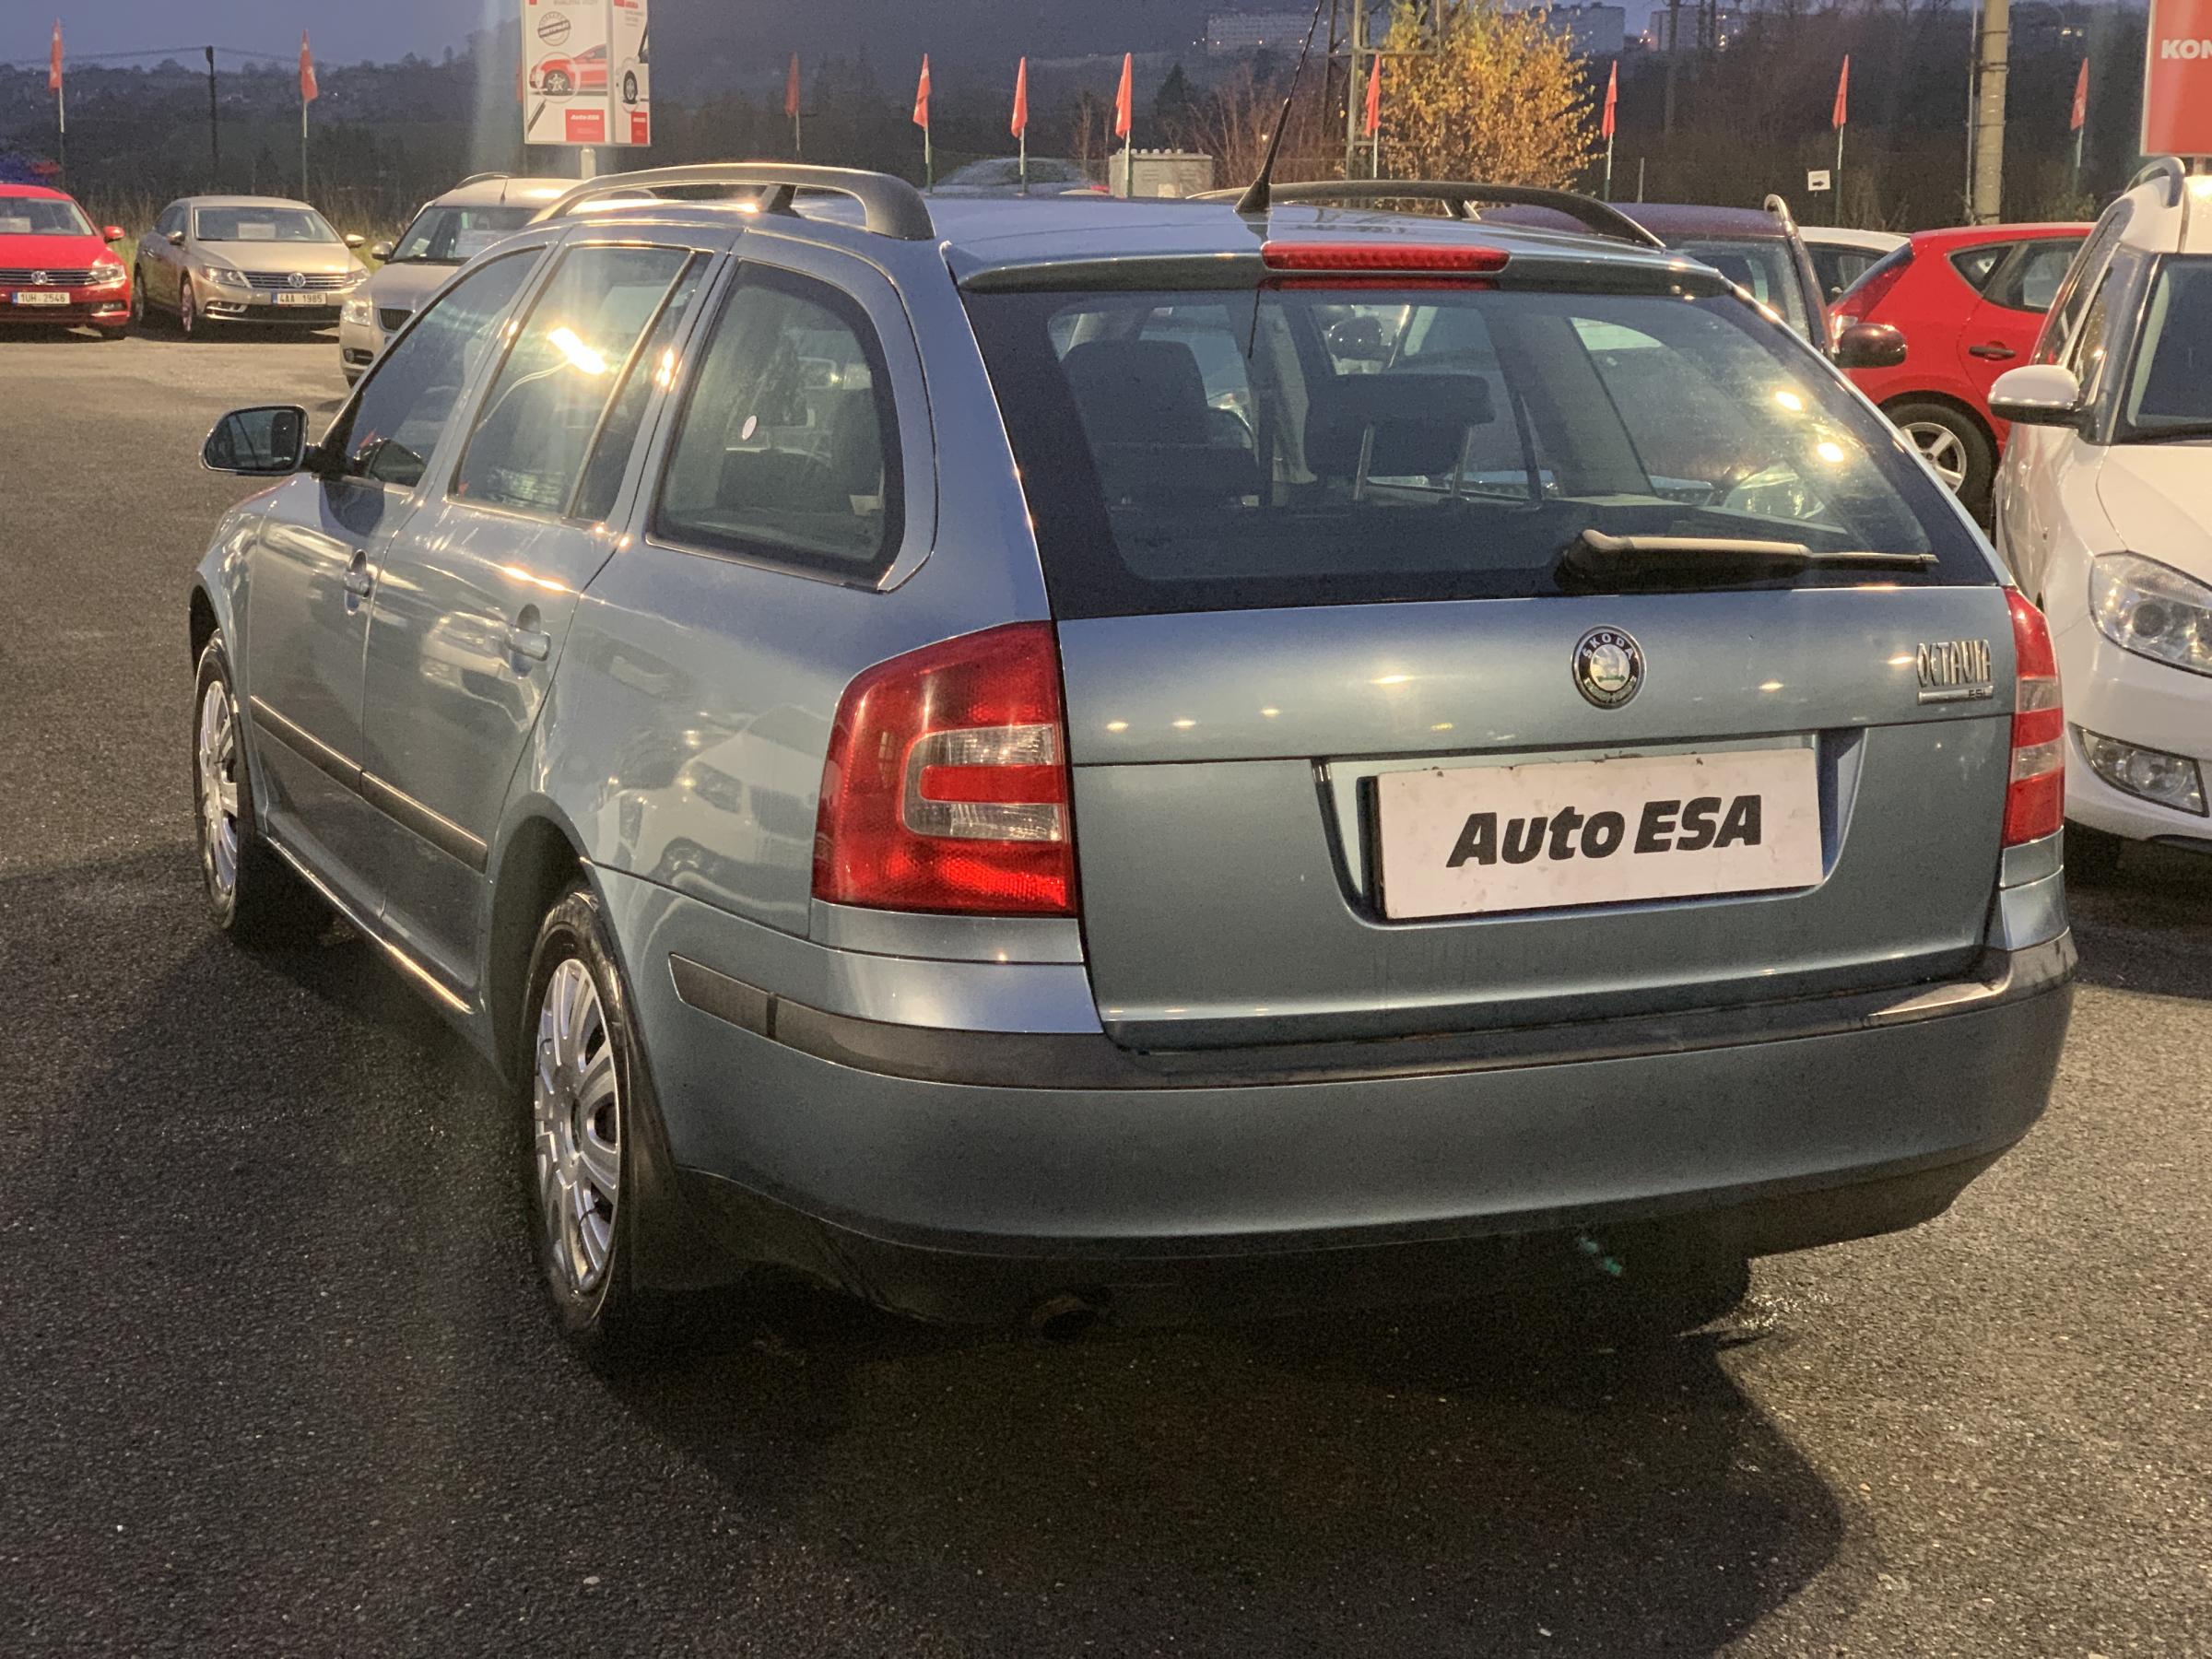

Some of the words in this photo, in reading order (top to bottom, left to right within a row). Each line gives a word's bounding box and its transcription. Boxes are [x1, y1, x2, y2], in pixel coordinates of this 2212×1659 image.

[279, 294, 295, 303] 4AA
[1916, 639, 1992, 688] OCTAVIA
[1445, 806, 1626, 868] Auto
[1633, 794, 1762, 853] ESA
